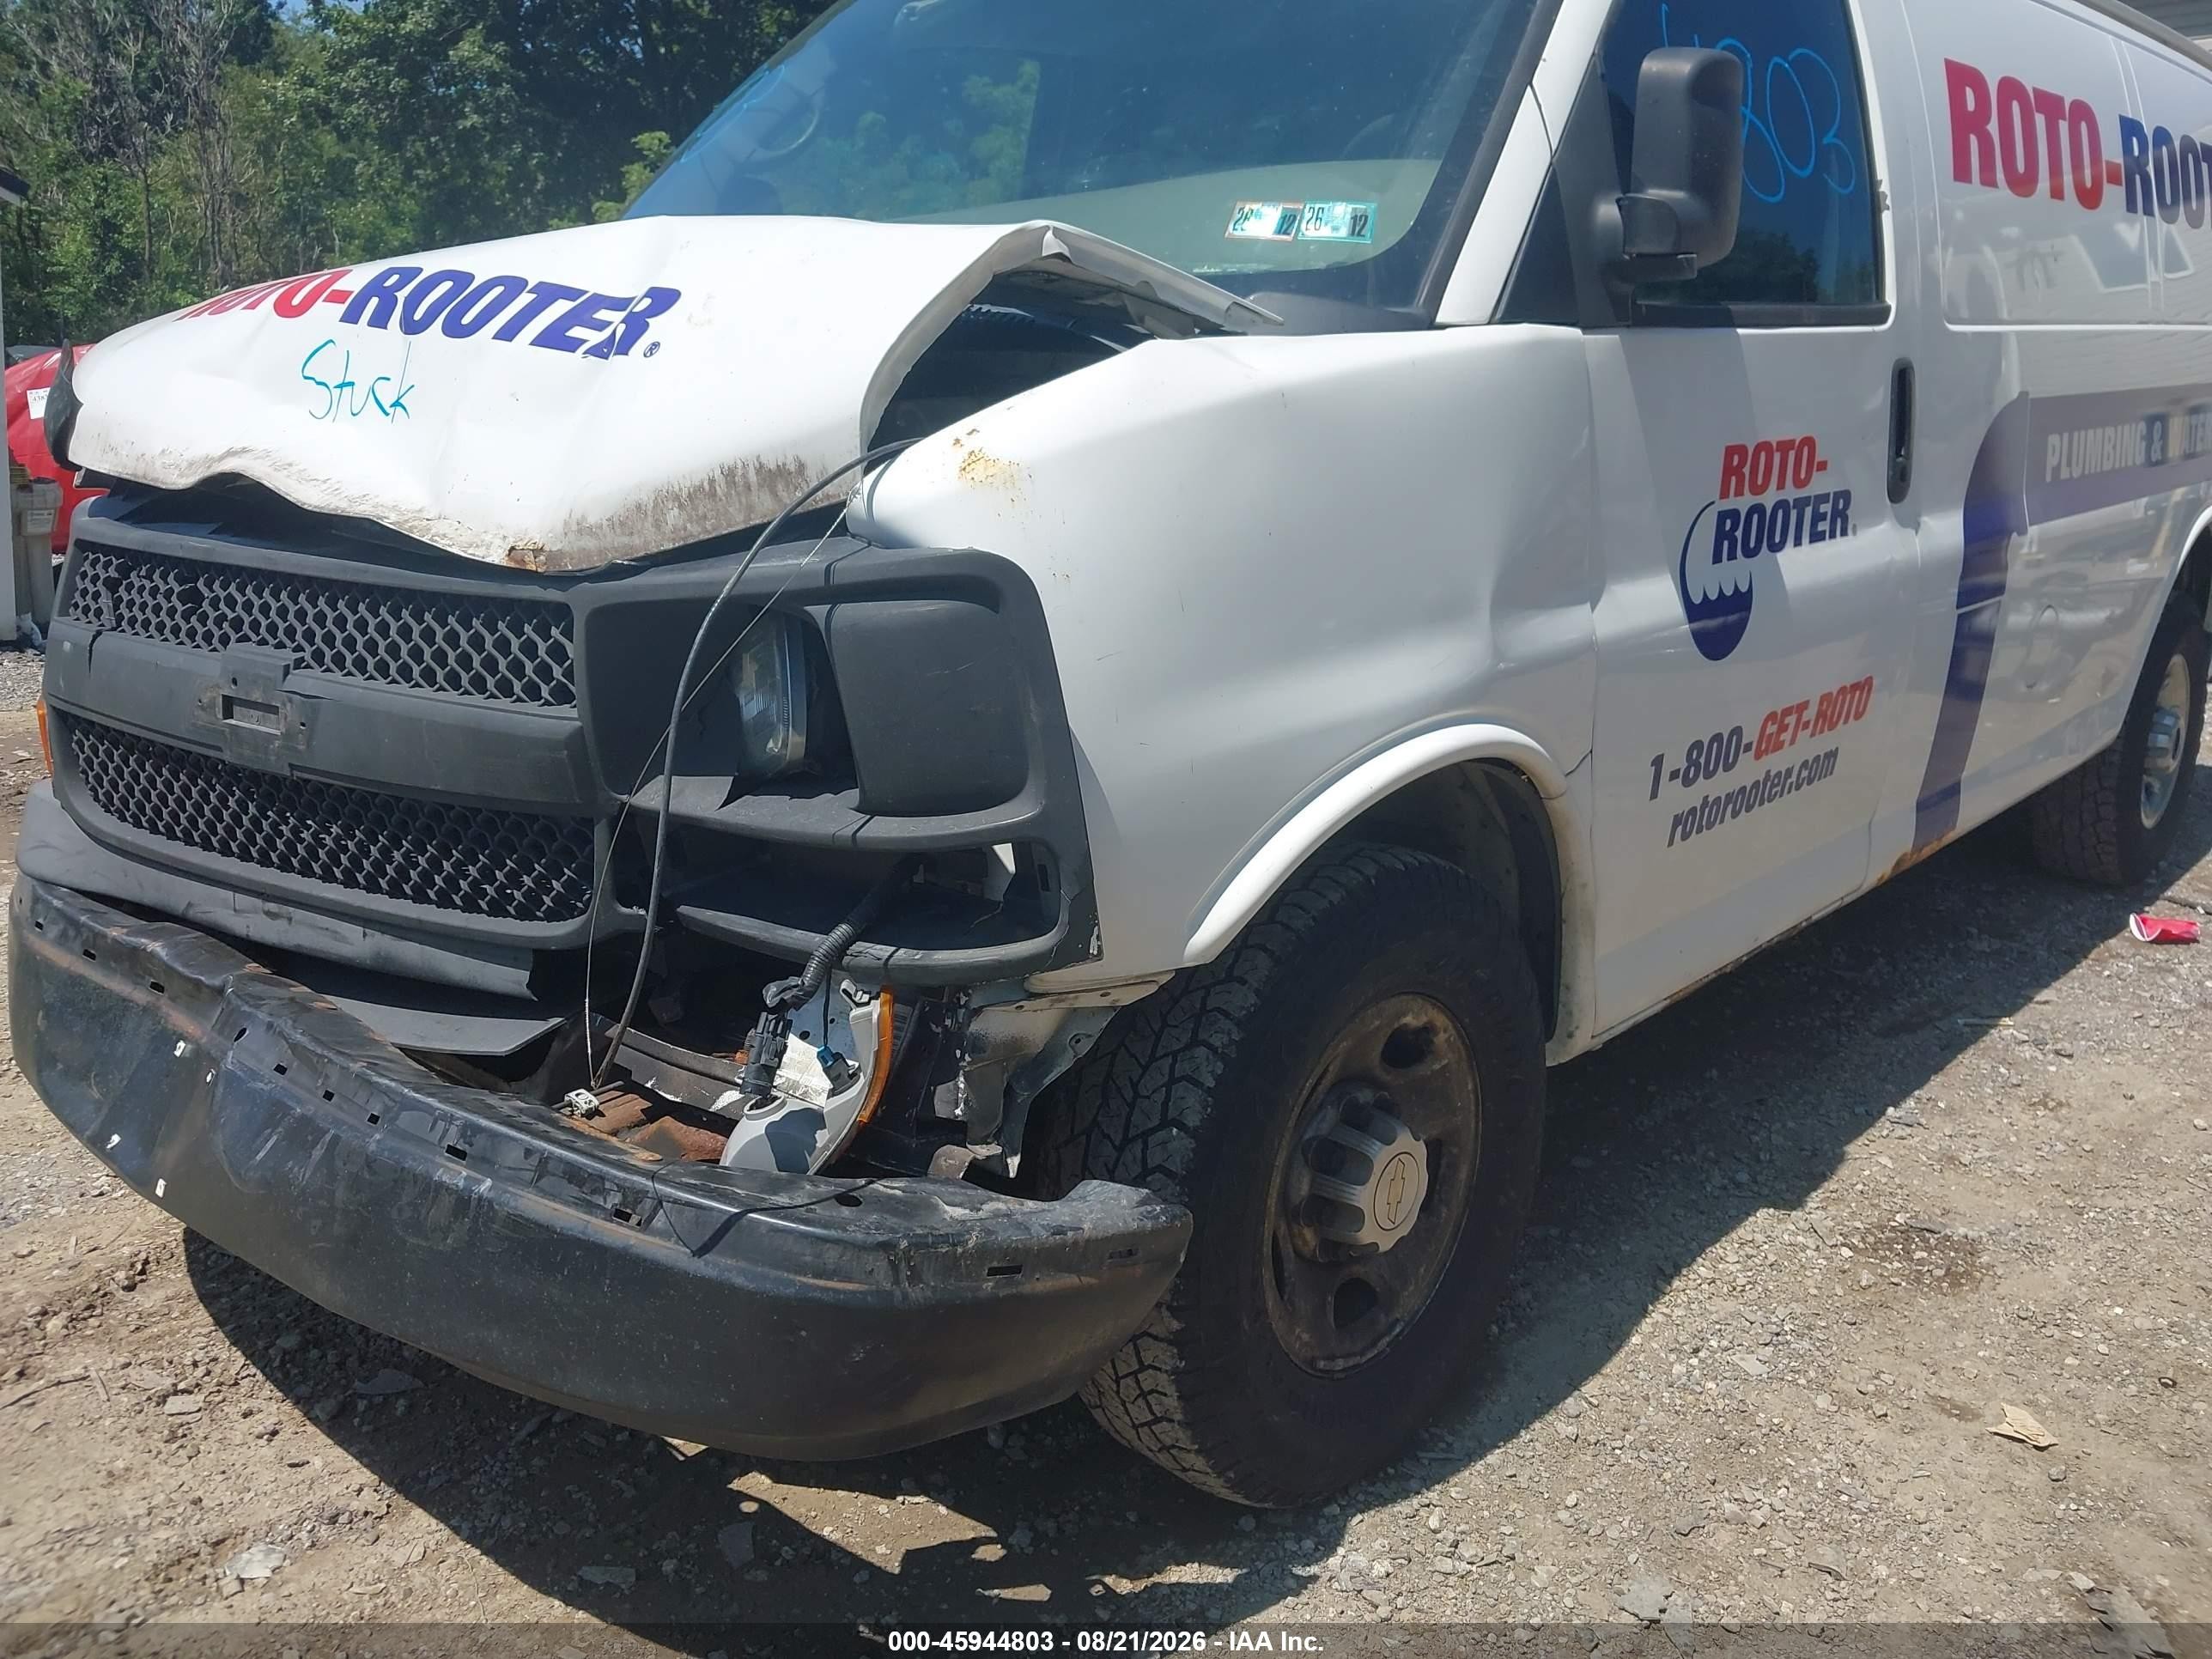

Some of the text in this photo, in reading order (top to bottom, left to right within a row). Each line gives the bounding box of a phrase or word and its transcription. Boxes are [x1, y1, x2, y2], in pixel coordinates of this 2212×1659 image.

[1304, 205, 1369, 237] 26 12
[1718, 435, 1828, 500] ROTO-
[2045, 420, 2147, 483] PLUMBING
[2149, 420, 2163, 462] &
[1711, 489, 1852, 565] ROOTER
[1649, 675, 1874, 801] 1-800-GET-ROTO
[1667, 746, 1839, 848] rotorooter.com
